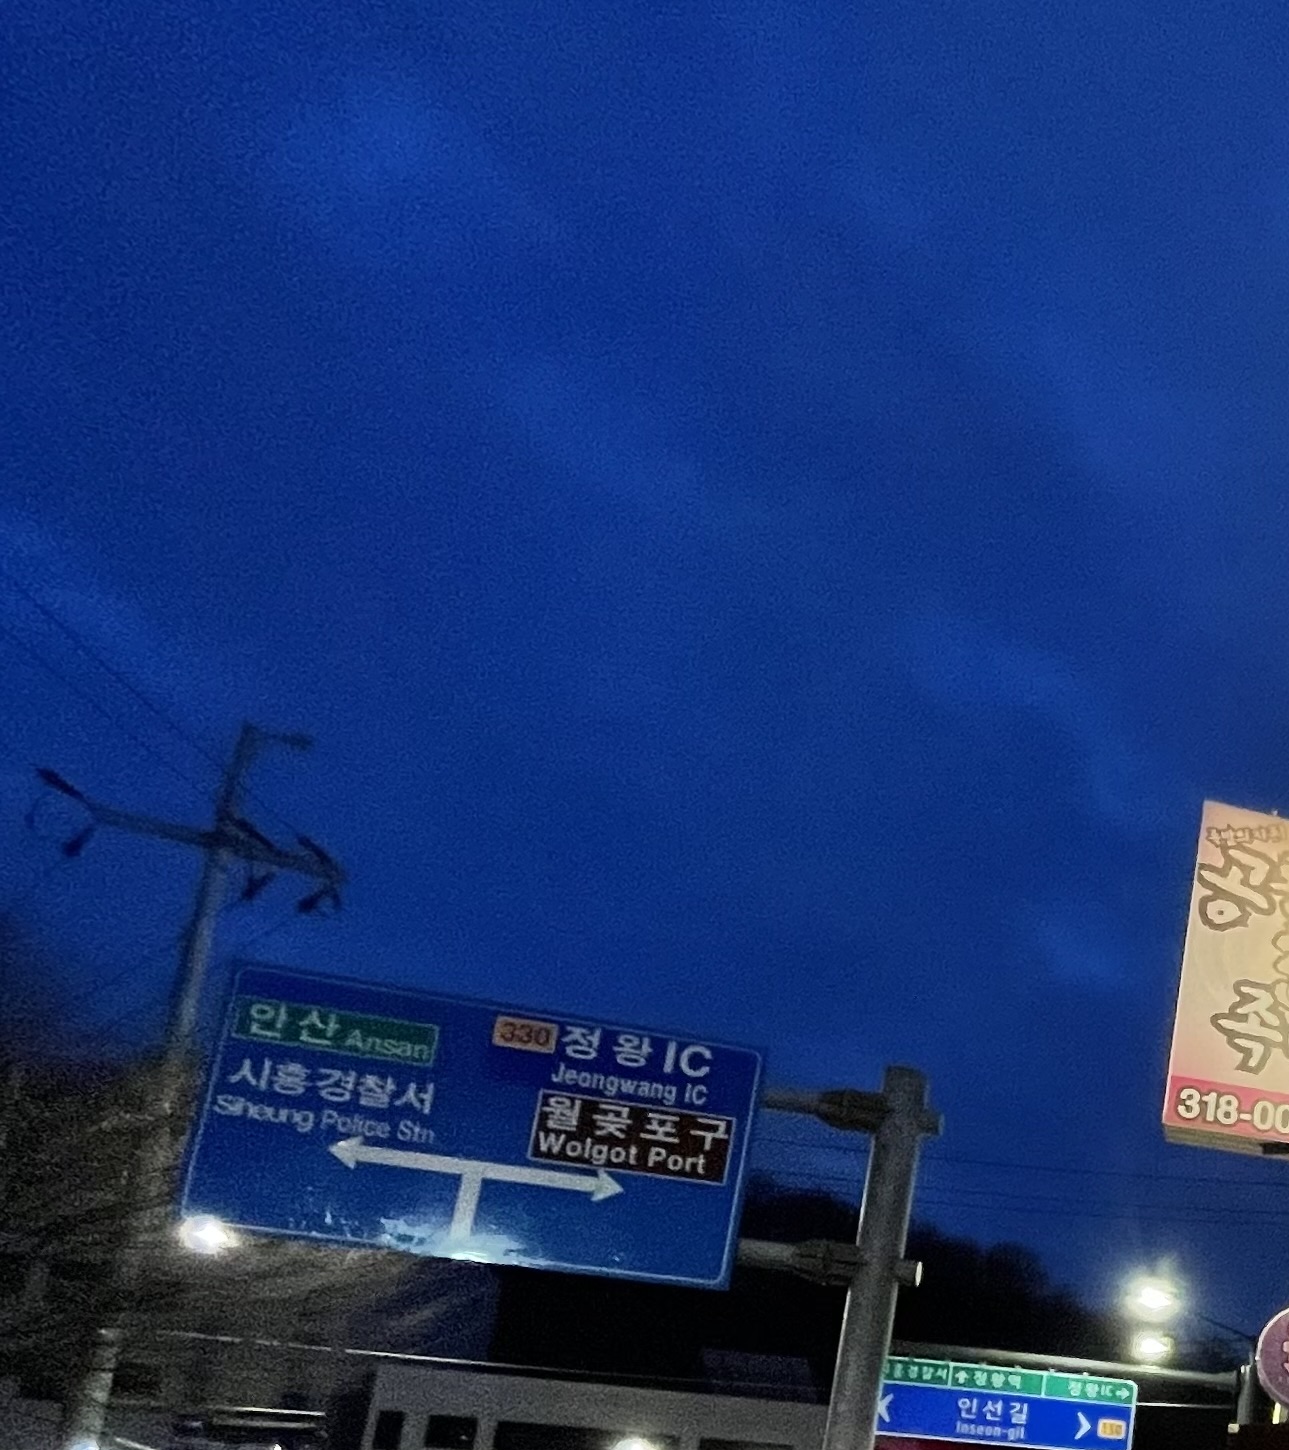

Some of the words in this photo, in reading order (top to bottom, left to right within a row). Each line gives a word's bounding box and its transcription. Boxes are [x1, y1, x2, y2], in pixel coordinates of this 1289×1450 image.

[251, 1003, 341, 1046] 안산
[345, 1029, 429, 1061] Ansan
[500, 1021, 550, 1048] 330
[561, 1026, 653, 1068] 정왕
[663, 1040, 713, 1078] IC
[227, 1056, 435, 1116] 시흥경찰서
[551, 1061, 677, 1106] Jeongwang
[684, 1082, 709, 1106] IC
[320, 1108, 391, 1139] Police
[542, 1096, 729, 1151] 월곶포구
[538, 1130, 638, 1166] Wolgot
[647, 1146, 706, 1175] Port
[955, 1420, 1026, 1441] Inseon-gil
[957, 1397, 1029, 1426] 인선길
